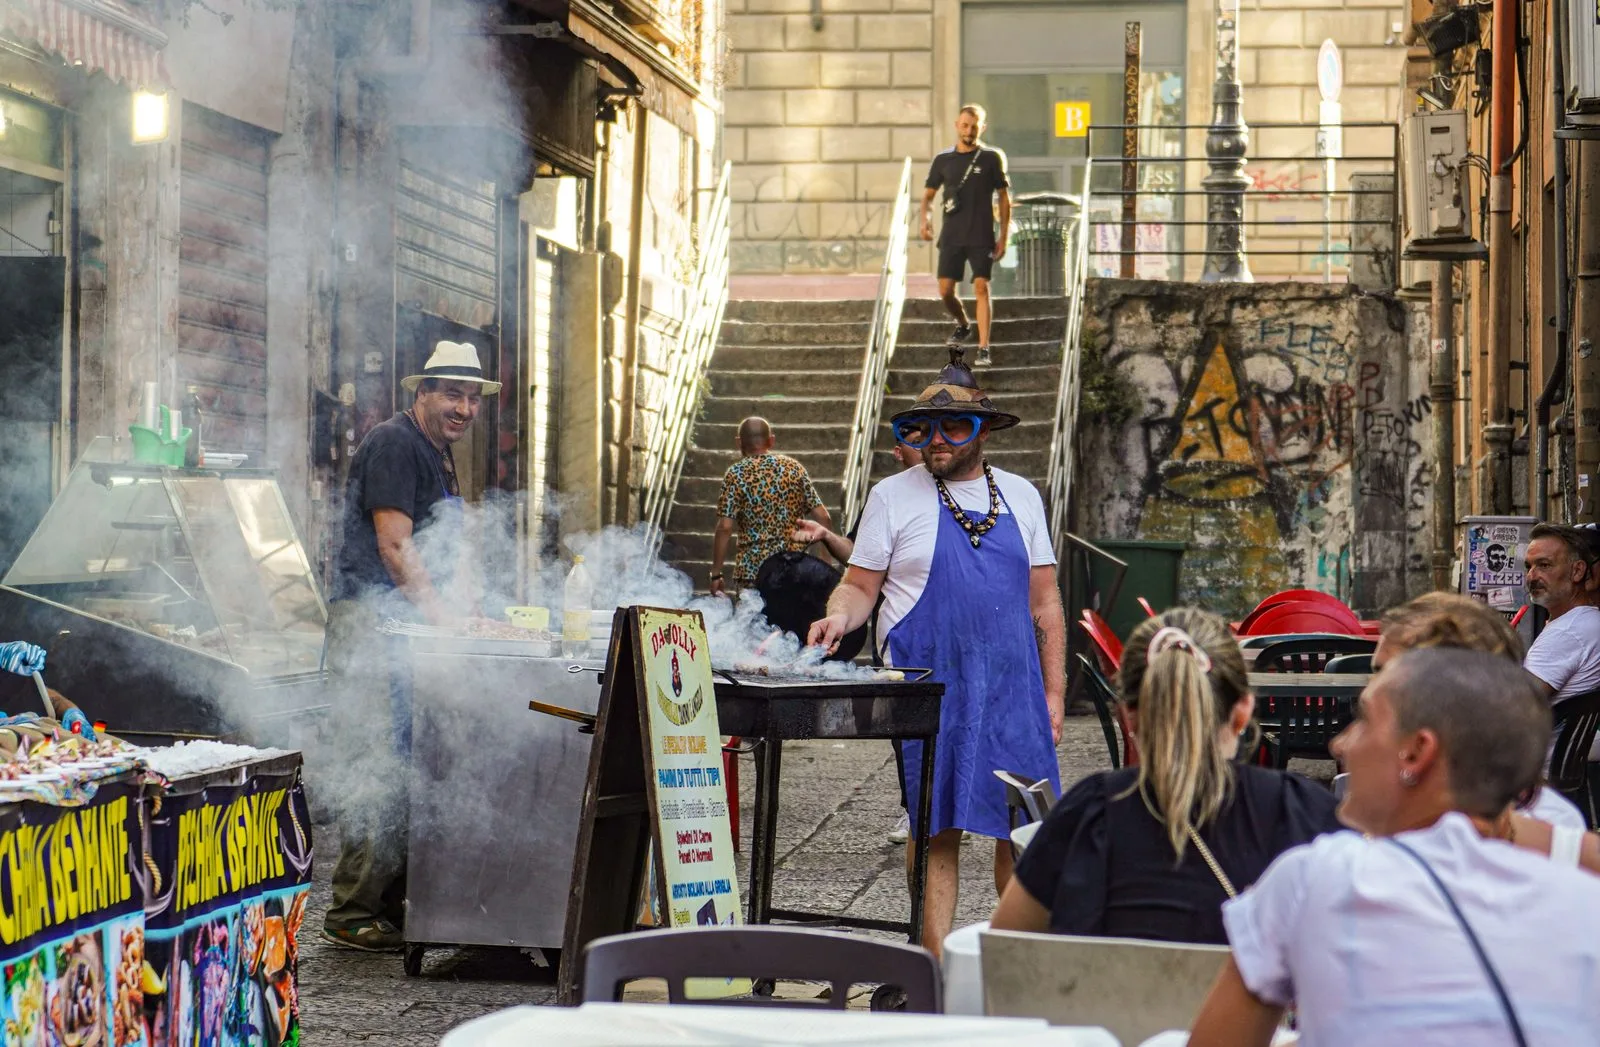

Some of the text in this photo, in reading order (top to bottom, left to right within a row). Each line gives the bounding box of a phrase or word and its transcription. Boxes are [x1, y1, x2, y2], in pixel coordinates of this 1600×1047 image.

[1064, 107, 1083, 131] B
[651, 626, 665, 657] DA
[684, 768, 702, 787] TUTTI
